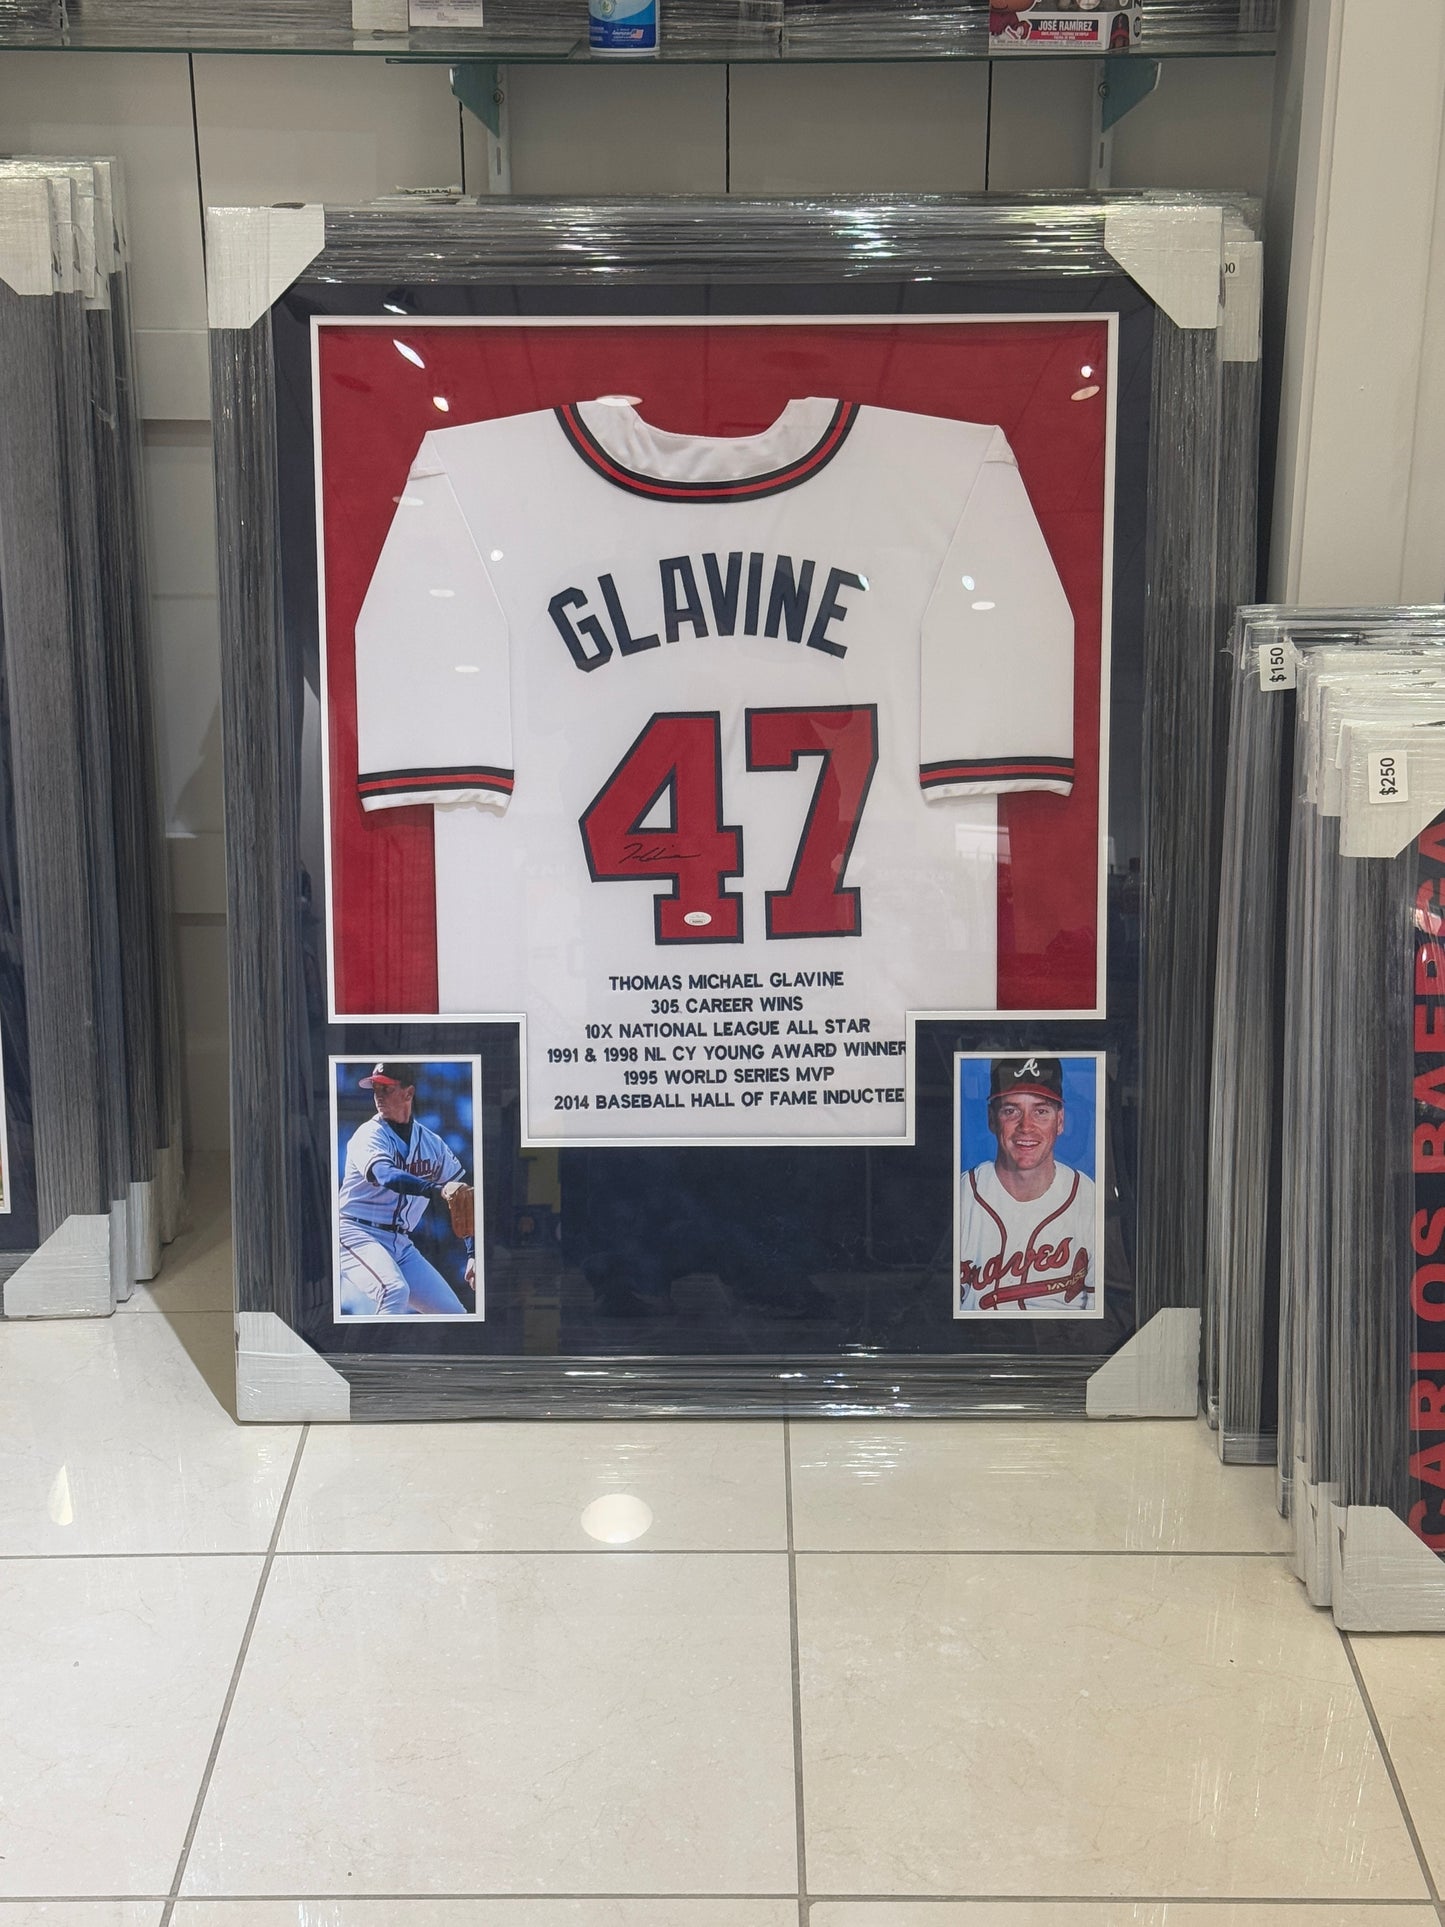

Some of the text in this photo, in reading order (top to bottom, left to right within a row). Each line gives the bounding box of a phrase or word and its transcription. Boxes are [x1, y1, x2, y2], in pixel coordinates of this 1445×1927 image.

[1038, 19, 1093, 31] JOSÉ RAMÍREZ
[548, 551, 869, 673] GLAVINE
[1269, 647, 1286, 683] $150
[1379, 757, 1398, 796] $250
[578, 703, 879, 945] 47
[608, 971, 845, 991] THOMAS MICHAEL GLAVINE
[650, 995, 804, 1015] 305 CAREER WINS
[584, 1018, 871, 1039] 10X NATIONAL LEAGUE ALL STAR
[546, 1040, 906, 1064] 1991 & 1998 NL CY YOUNG AWARD WINNER
[623, 1066, 835, 1086] 1995 WORLD SERIES MVP
[554, 1087, 905, 1111] 2014 BASEBALL HALL OF FAME INDUCTEE
